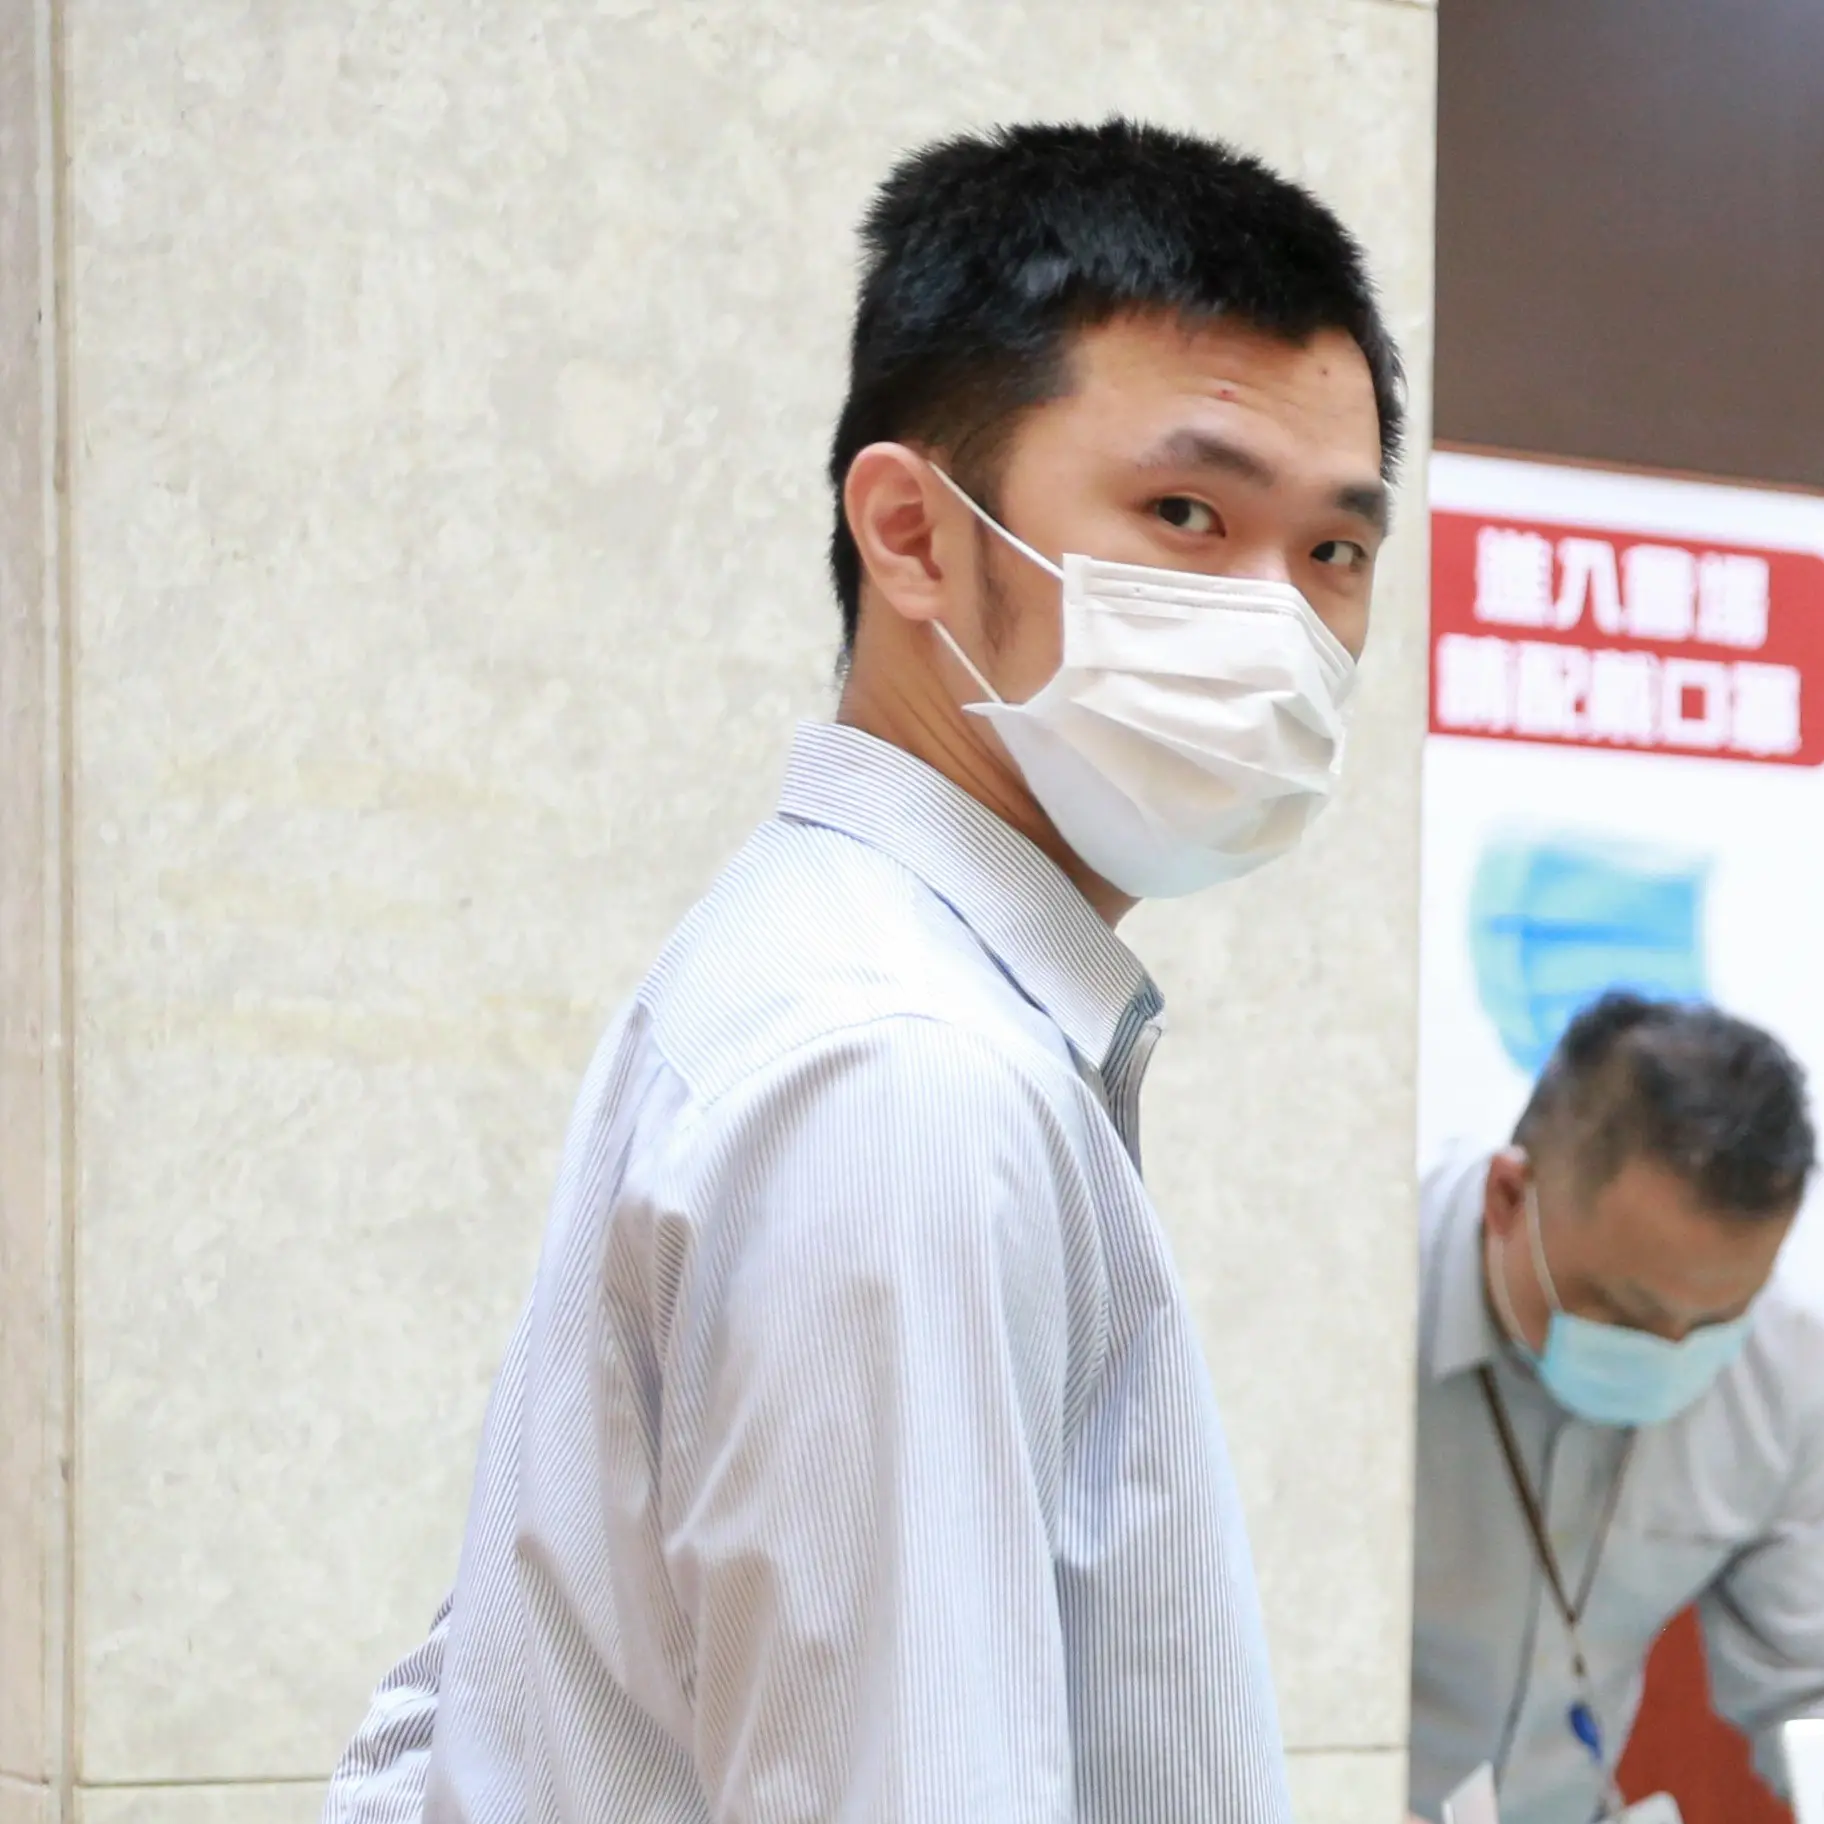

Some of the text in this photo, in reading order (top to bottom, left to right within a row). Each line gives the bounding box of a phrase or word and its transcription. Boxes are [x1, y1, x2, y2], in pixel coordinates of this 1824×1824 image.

[1475, 525, 1770, 650] 進入會場
[1435, 632, 1803, 758] 請配戴口罩
